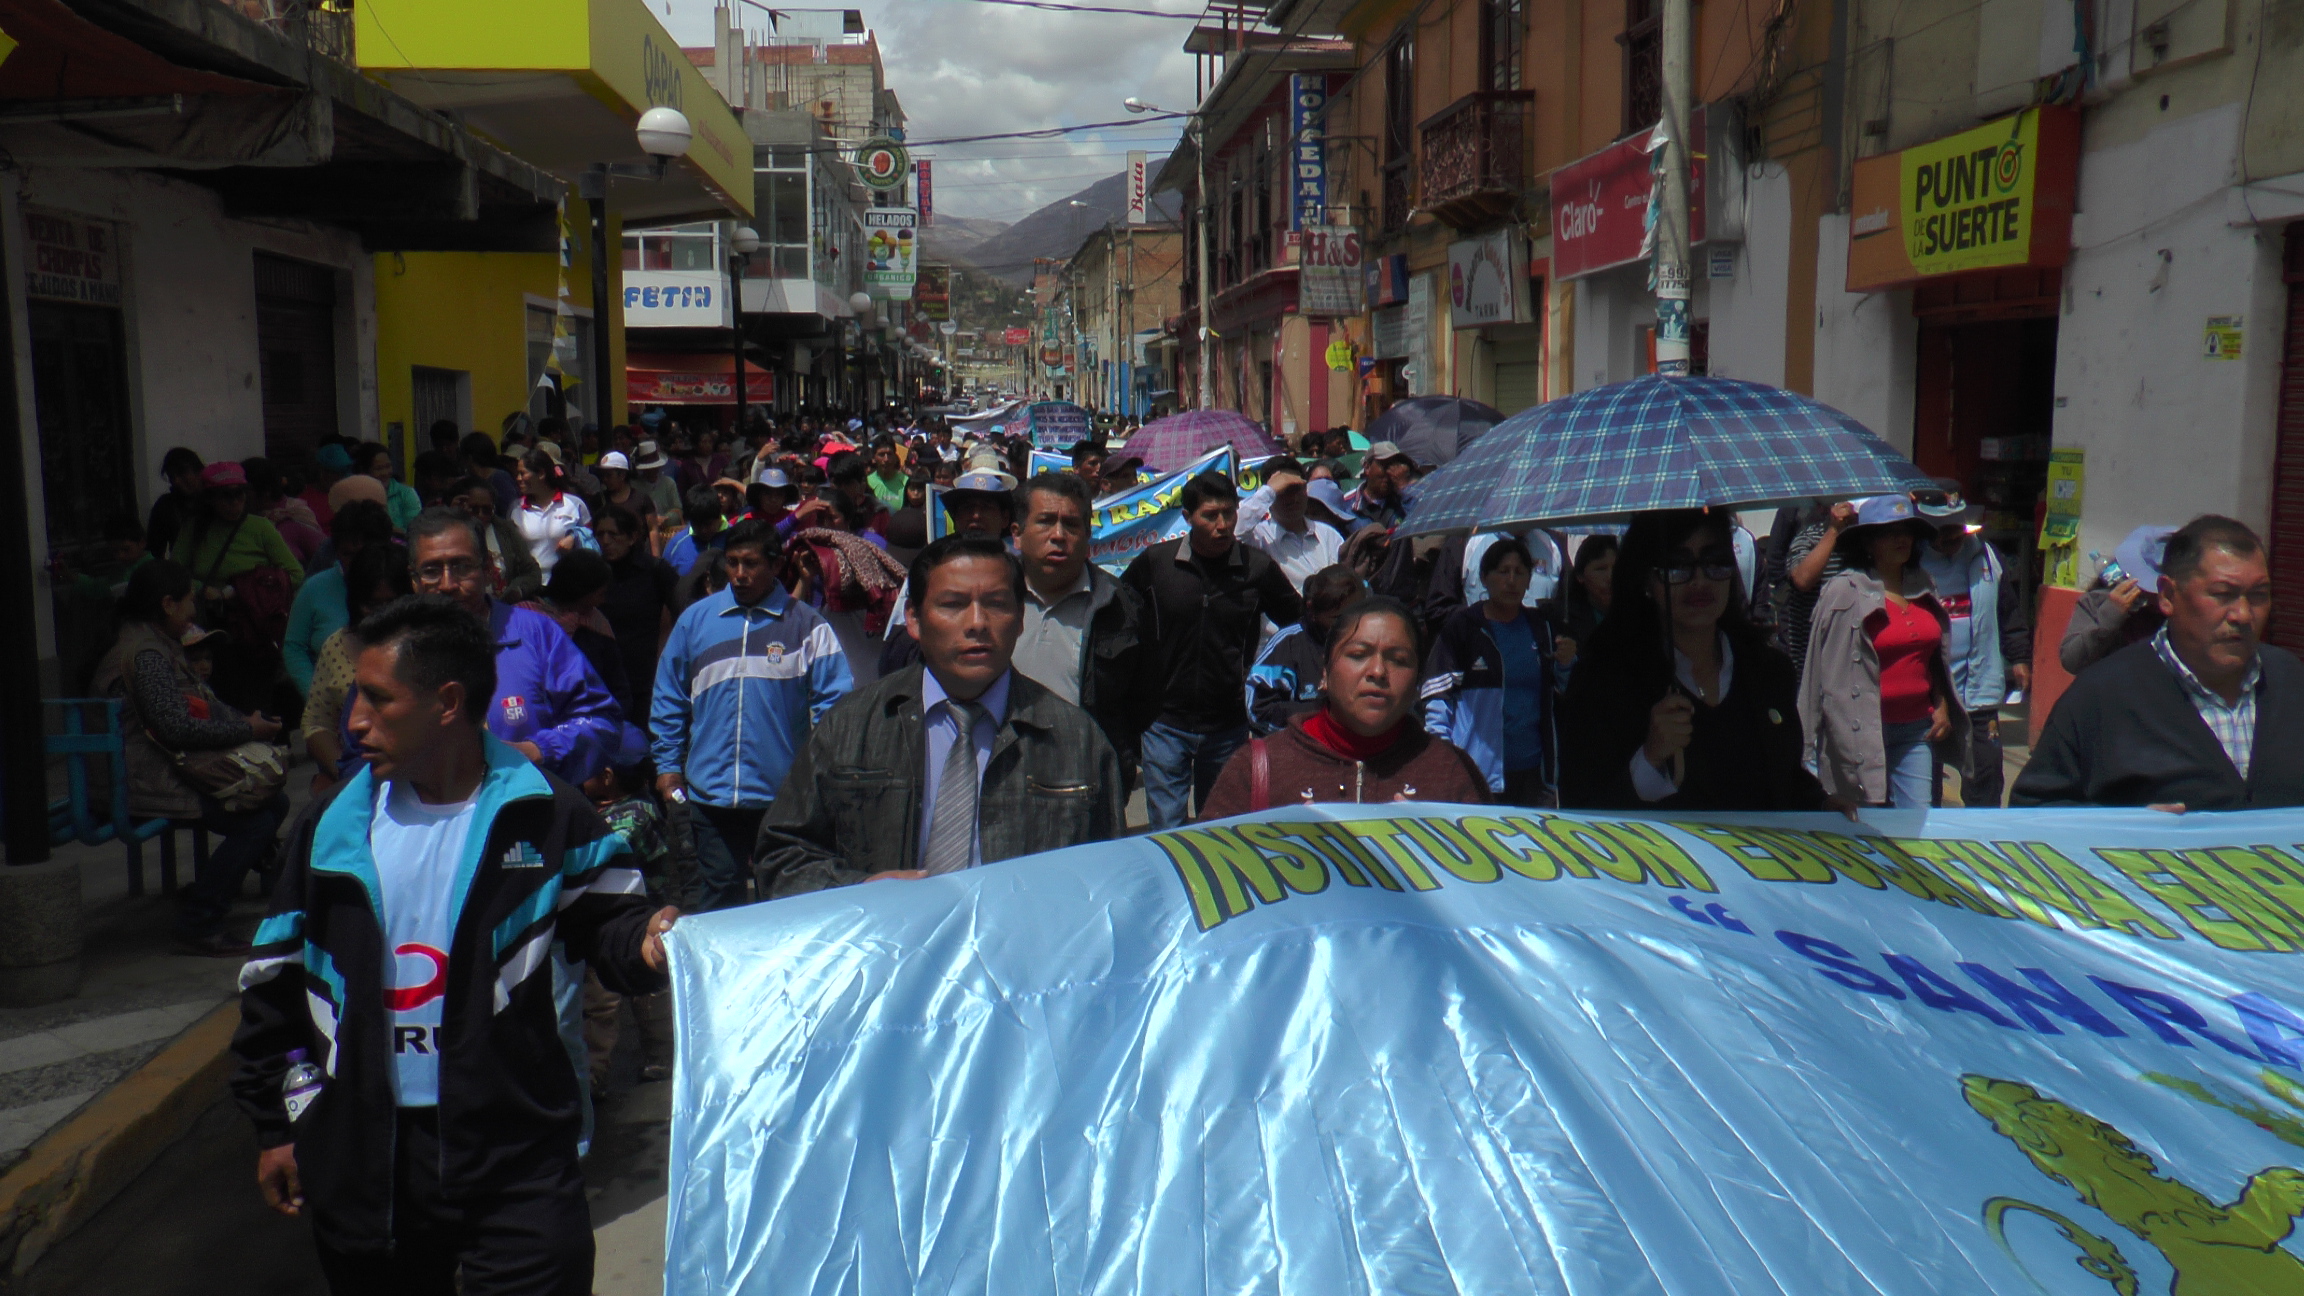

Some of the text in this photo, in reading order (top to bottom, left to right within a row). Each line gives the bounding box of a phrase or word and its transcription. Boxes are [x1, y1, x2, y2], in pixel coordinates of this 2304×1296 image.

[1131, 162, 1143, 214] Bata
[867, 213, 913, 227] HELADOS
[1560, 199, 1597, 241] Claro
[1924, 197, 2020, 256] SUERTE
[37, 245, 101, 280] CHOMPAS
[1305, 228, 1360, 267] H&S
[506, 706, 524, 720] SR
[1149, 814, 1720, 933] INSTITUCIÓN
